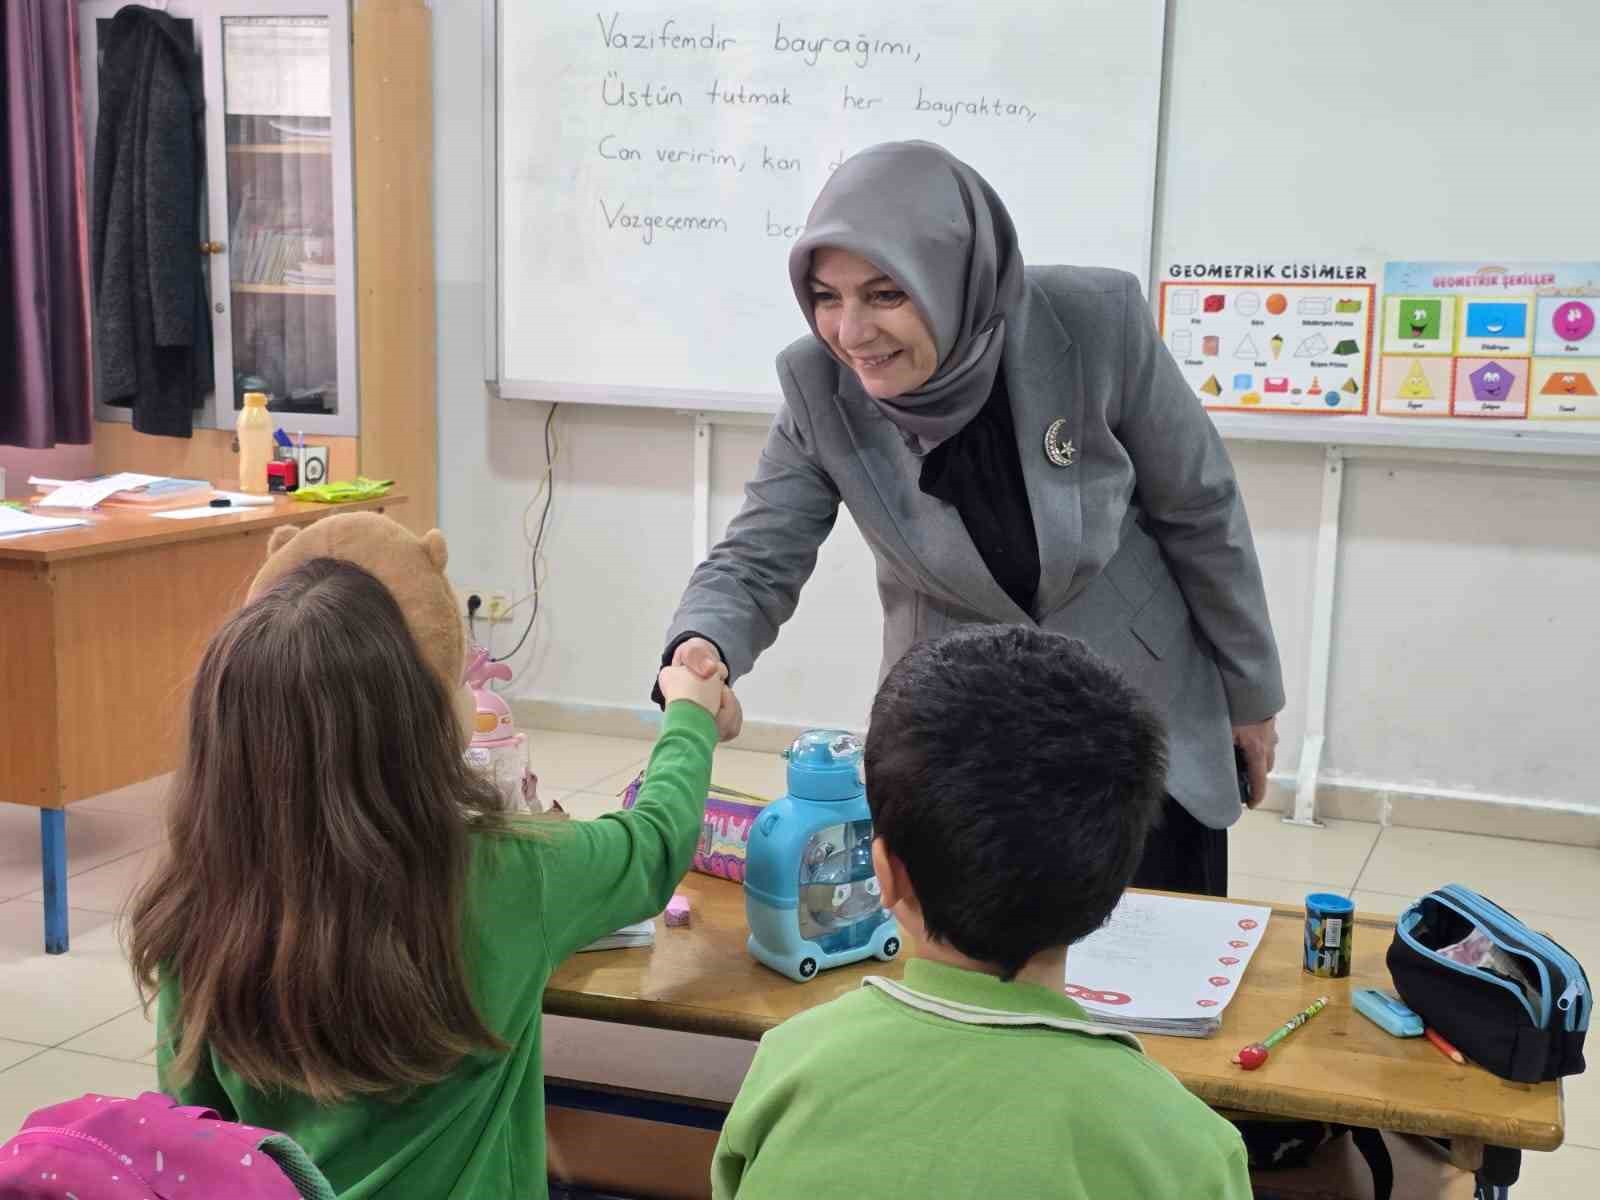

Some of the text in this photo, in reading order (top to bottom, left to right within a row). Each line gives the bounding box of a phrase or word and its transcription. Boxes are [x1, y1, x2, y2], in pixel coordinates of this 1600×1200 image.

[597, 11, 922, 69] Vazifemdir bayrağımı,
[601, 70, 1038, 128] Üstün tutmak her bayraktan,
[598, 134, 642, 161] Can
[656, 145, 747, 173] veririm,
[762, 144, 802, 172] kan
[599, 199, 728, 246] Vazgeçemem
[1169, 263, 1368, 280] GEOMETRİK CİSİMLER
